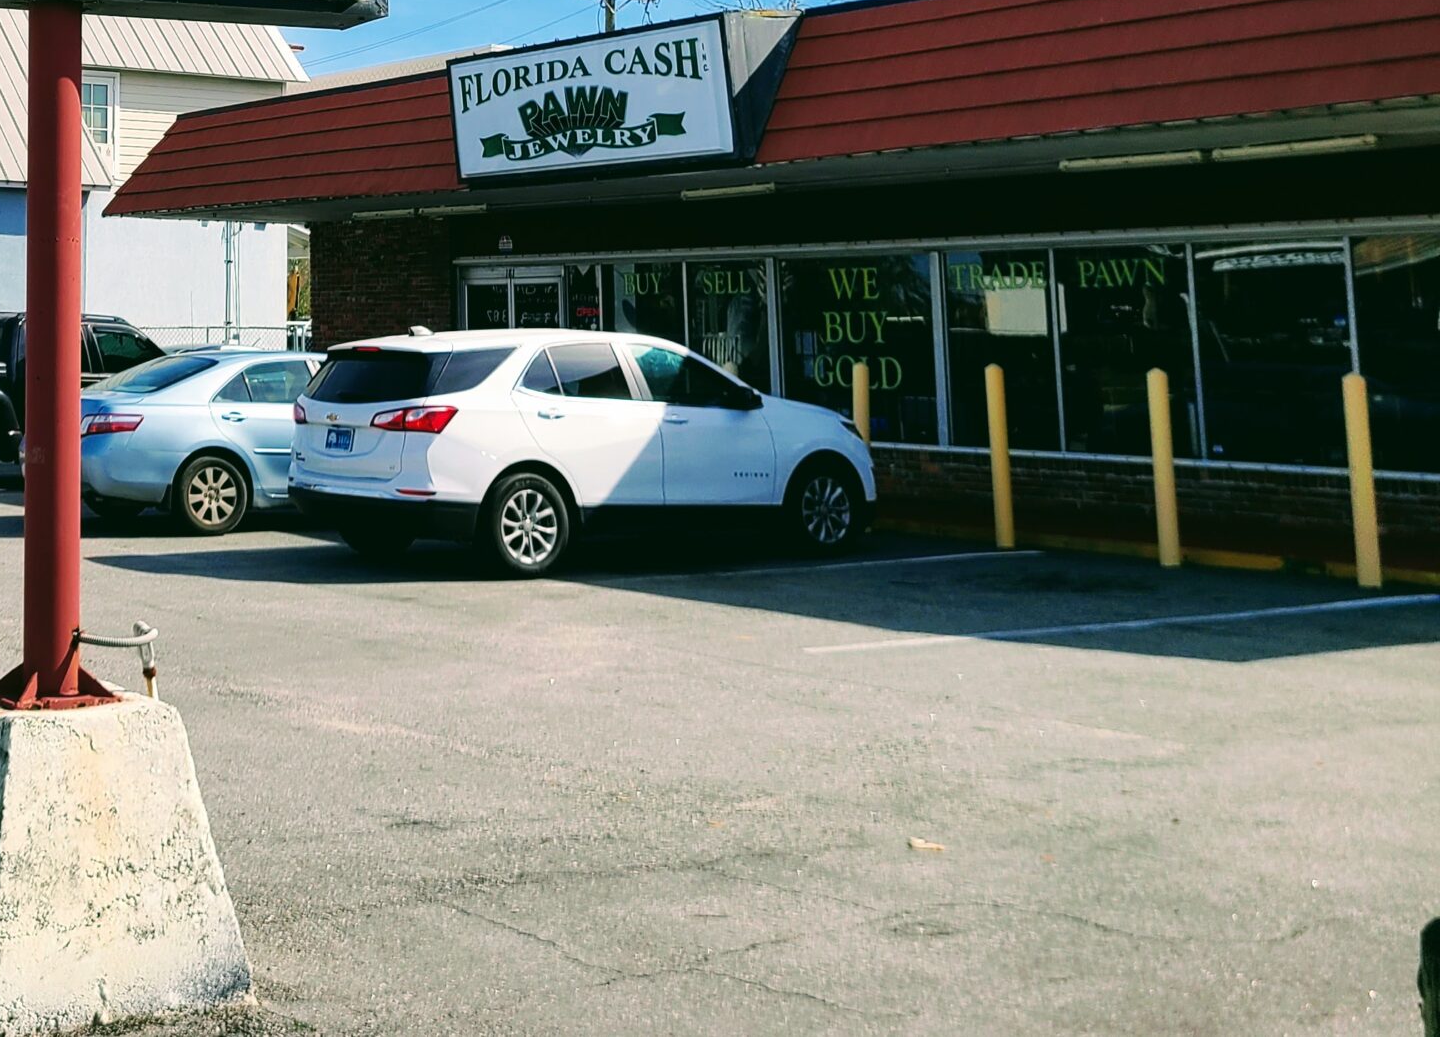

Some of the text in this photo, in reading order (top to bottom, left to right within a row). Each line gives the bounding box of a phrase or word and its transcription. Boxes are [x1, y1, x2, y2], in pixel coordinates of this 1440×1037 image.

[458, 37, 703, 114] FLORIDA CASH
[517, 84, 629, 135] PAWN
[508, 124, 654, 160] JEWELRY
[623, 272, 662, 295] BUY
[702, 270, 752, 295] SELL
[827, 267, 880, 300] WE
[949, 261, 1047, 292] TRADE
[1076, 258, 1167, 289] PAWN
[821, 310, 888, 344] BUY
